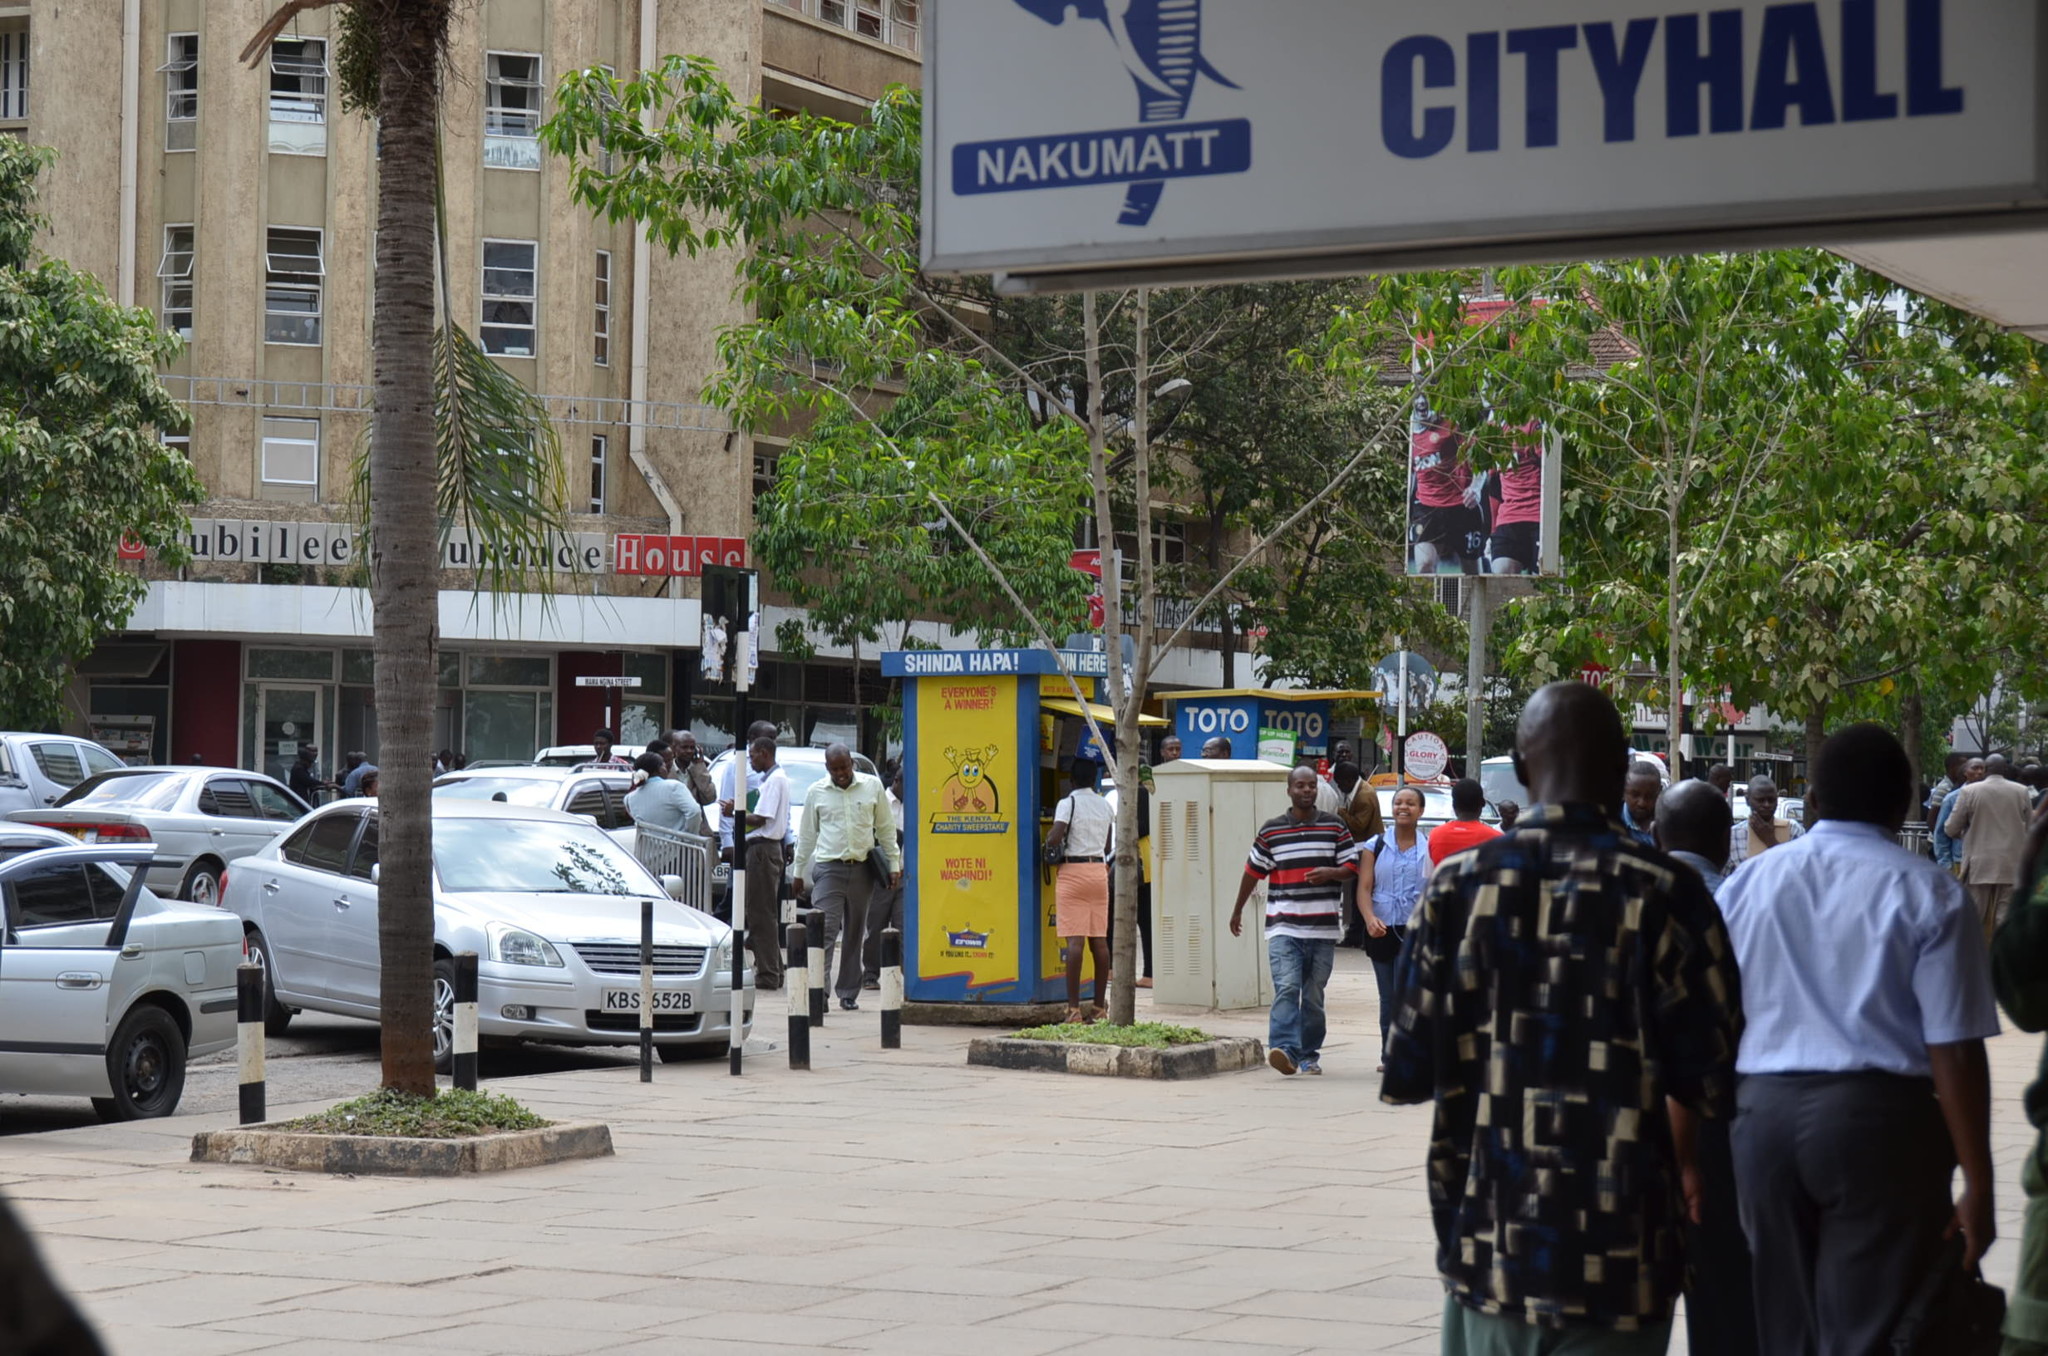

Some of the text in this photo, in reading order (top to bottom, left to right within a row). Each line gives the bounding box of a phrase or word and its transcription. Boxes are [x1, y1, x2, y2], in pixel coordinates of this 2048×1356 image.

[1380, 0, 1964, 160] CITYHALL
[977, 129, 1220, 186] NAKUMATT
[190, 525, 349, 558] ubilee
[618, 539, 742, 570] House
[1464, 531, 1481, 549] 16
[904, 652, 1019, 673] SHINDA HAPA!
[1079, 653, 1107, 672] HERE
[941, 685, 996, 699] EVERYONE'S
[944, 699, 993, 710] A WINNER!
[1184, 706, 1249, 733] TOTO
[1406, 734, 1445, 750] CAUTION
[1409, 750, 1438, 759] GLORY
[935, 823, 961, 831] CHARITY
[945, 858, 986, 869] WOTE NI
[940, 869, 992, 881] WASHINDI!
[606, 991, 692, 1010] KBS 652B
